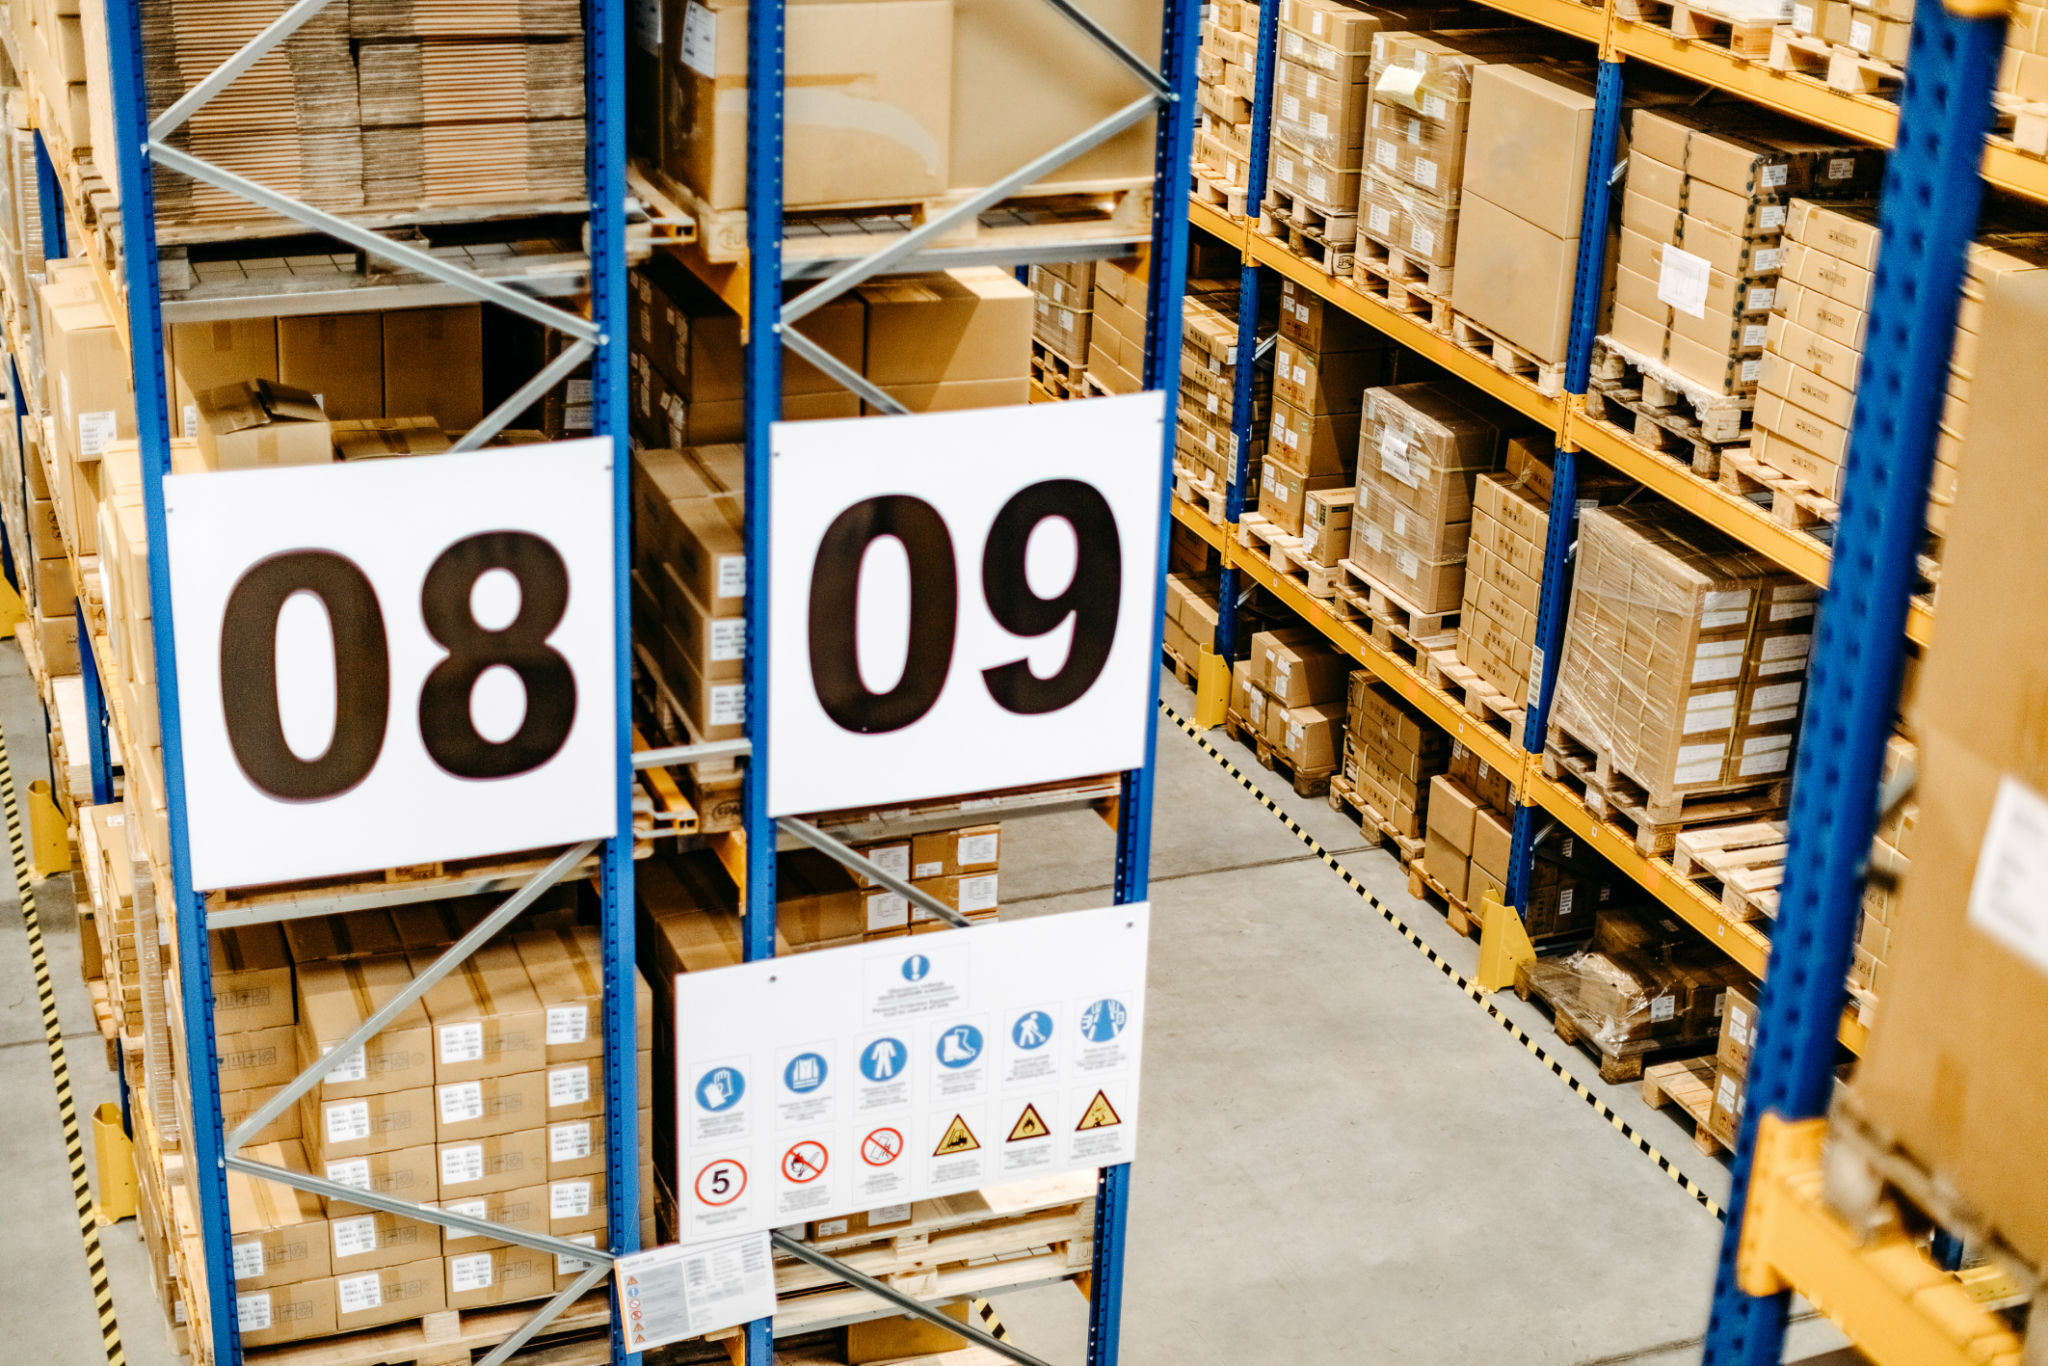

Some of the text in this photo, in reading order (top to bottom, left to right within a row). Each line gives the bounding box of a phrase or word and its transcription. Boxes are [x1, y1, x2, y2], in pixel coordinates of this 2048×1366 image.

[220, 529, 578, 802] 08
[808, 477, 1122, 735] 09
[711, 1168, 730, 1195] 5
